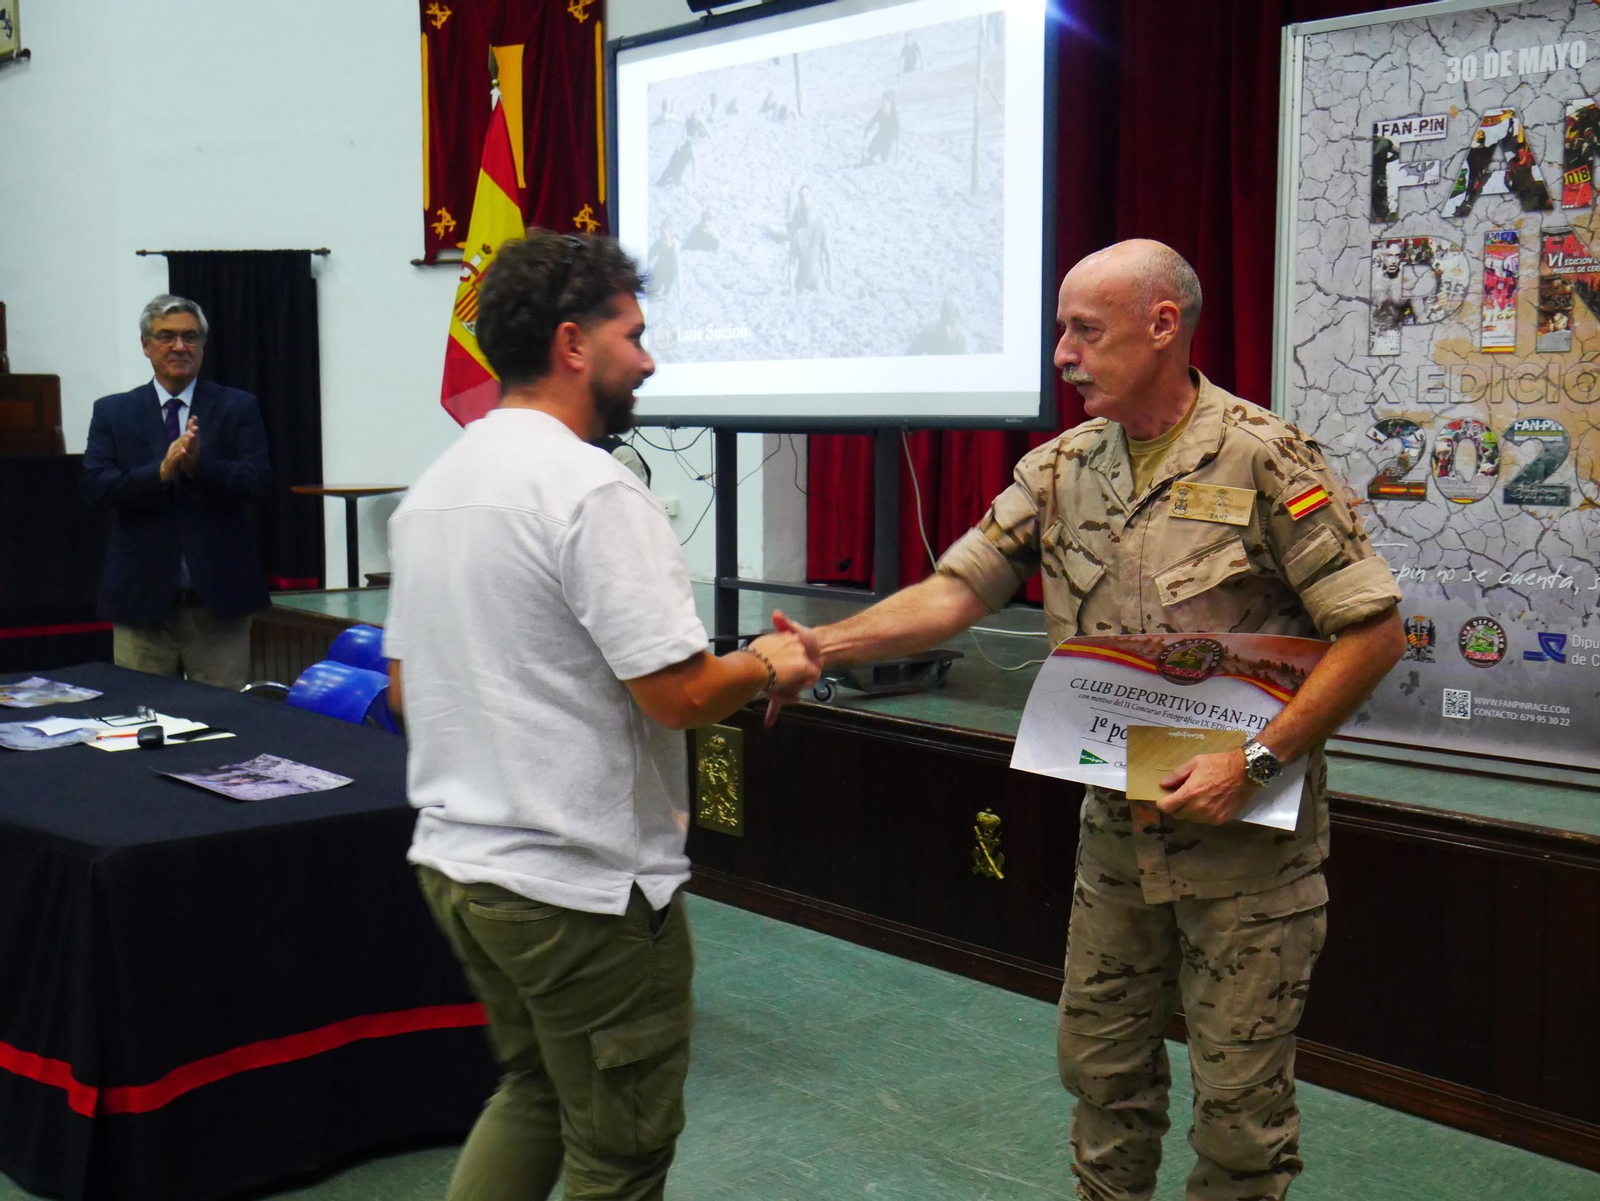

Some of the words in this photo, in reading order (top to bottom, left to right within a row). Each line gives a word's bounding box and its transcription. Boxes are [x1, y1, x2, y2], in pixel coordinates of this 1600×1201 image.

[1446, 54, 1477, 84] 30
[1483, 50, 1513, 80] DE
[1518, 40, 1587, 75] MAYO
[1381, 117, 1445, 136] FAN-PIN
[1564, 168, 1590, 186] 018
[1548, 252, 1563, 267] VI
[1365, 364, 1400, 404] X
[1437, 567, 1455, 583] no
[1462, 568, 1487, 583] se
[1571, 653, 1586, 665] de
[1070, 677, 1113, 694] CLUB
[1114, 684, 1206, 715] DEPORTIVO
[1091, 695, 1113, 705] motivo
[1113, 699, 1124, 707] del
[1131, 703, 1161, 715] Concurso
[1162, 711, 1199, 725] Fotográfico
[1200, 719, 1210, 728] IX
[1474, 697, 1570, 714] WWW.FANPINRACE.COM
[1089, 715, 1108, 733] 1º
[1474, 708, 1518, 719] CONTACTO:
[1520, 713, 1535, 722] 679
[1537, 715, 1547, 723] 95
[1548, 716, 1558, 725] 30
[1560, 718, 1570, 726] 22
